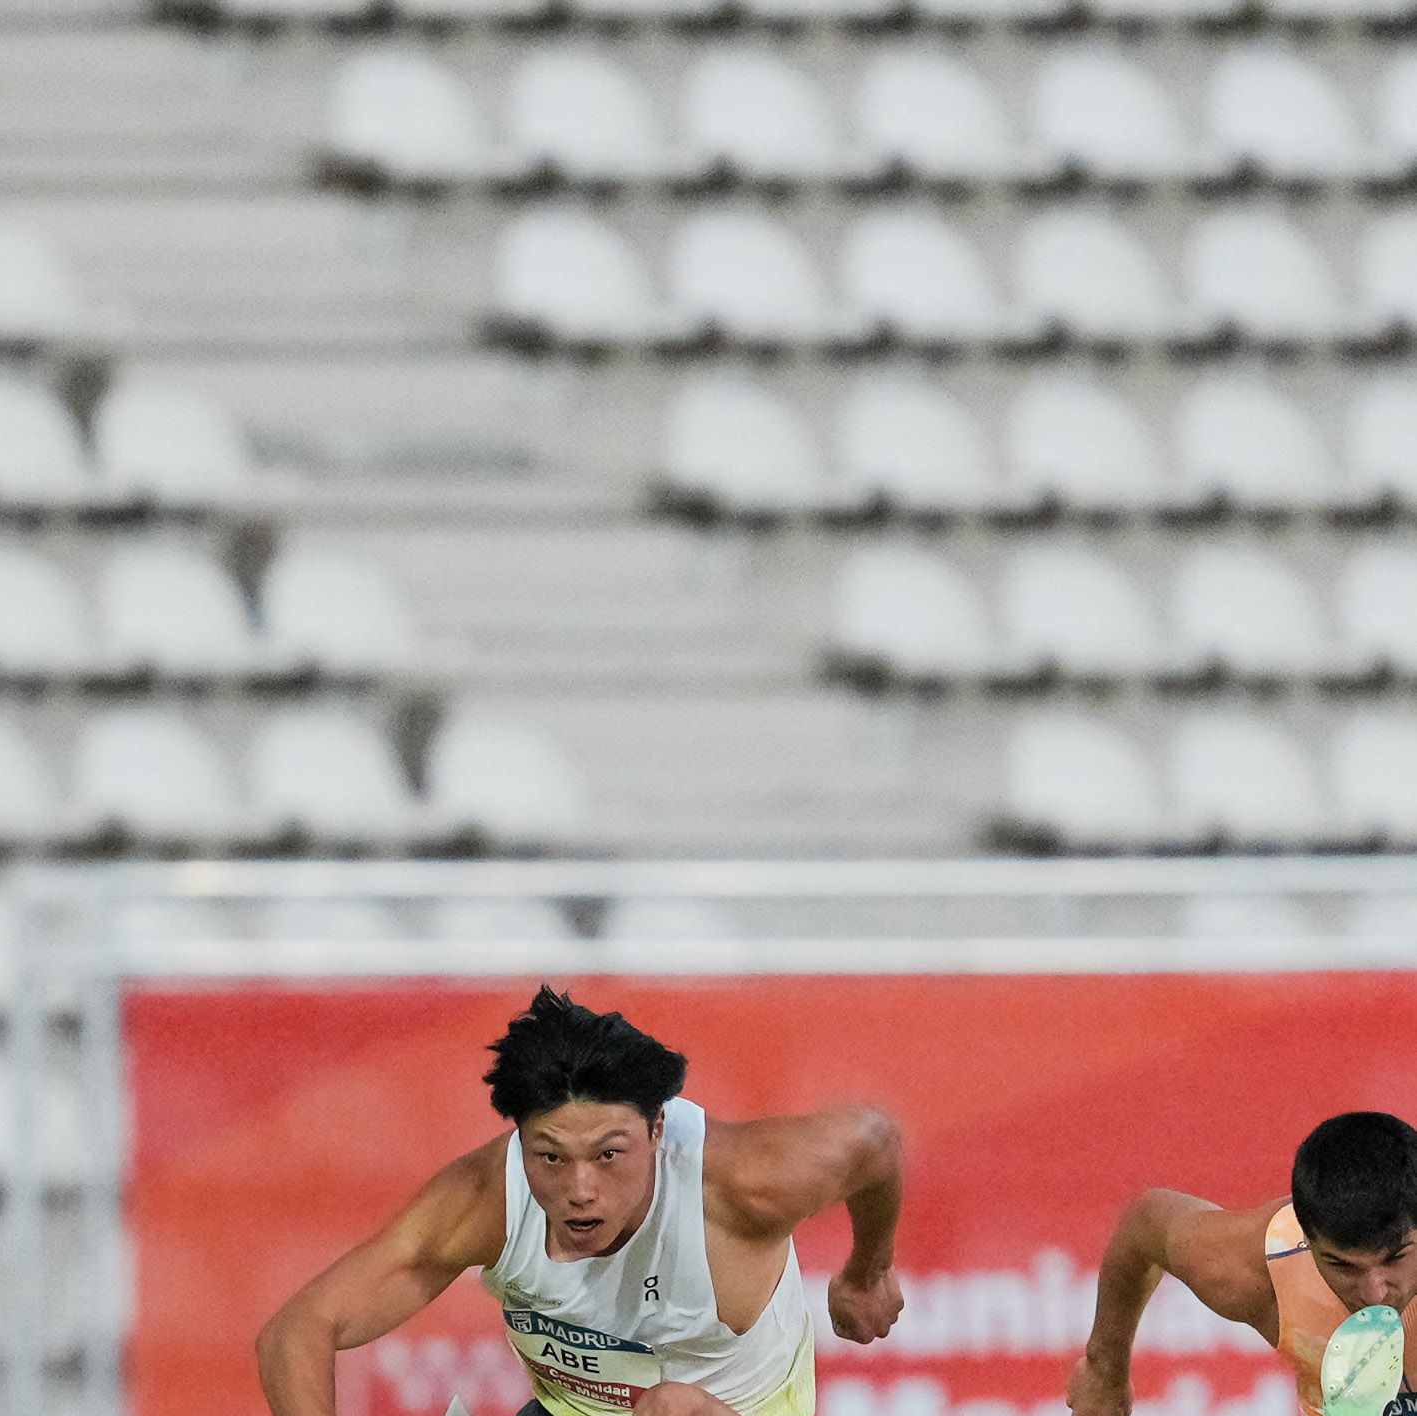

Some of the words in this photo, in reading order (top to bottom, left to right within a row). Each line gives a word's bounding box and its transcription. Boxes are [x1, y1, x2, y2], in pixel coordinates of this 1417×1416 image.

[537, 1318, 621, 1349] MADRID
[541, 1342, 600, 1374] ABE
[549, 1369, 631, 1397] Comunidad
